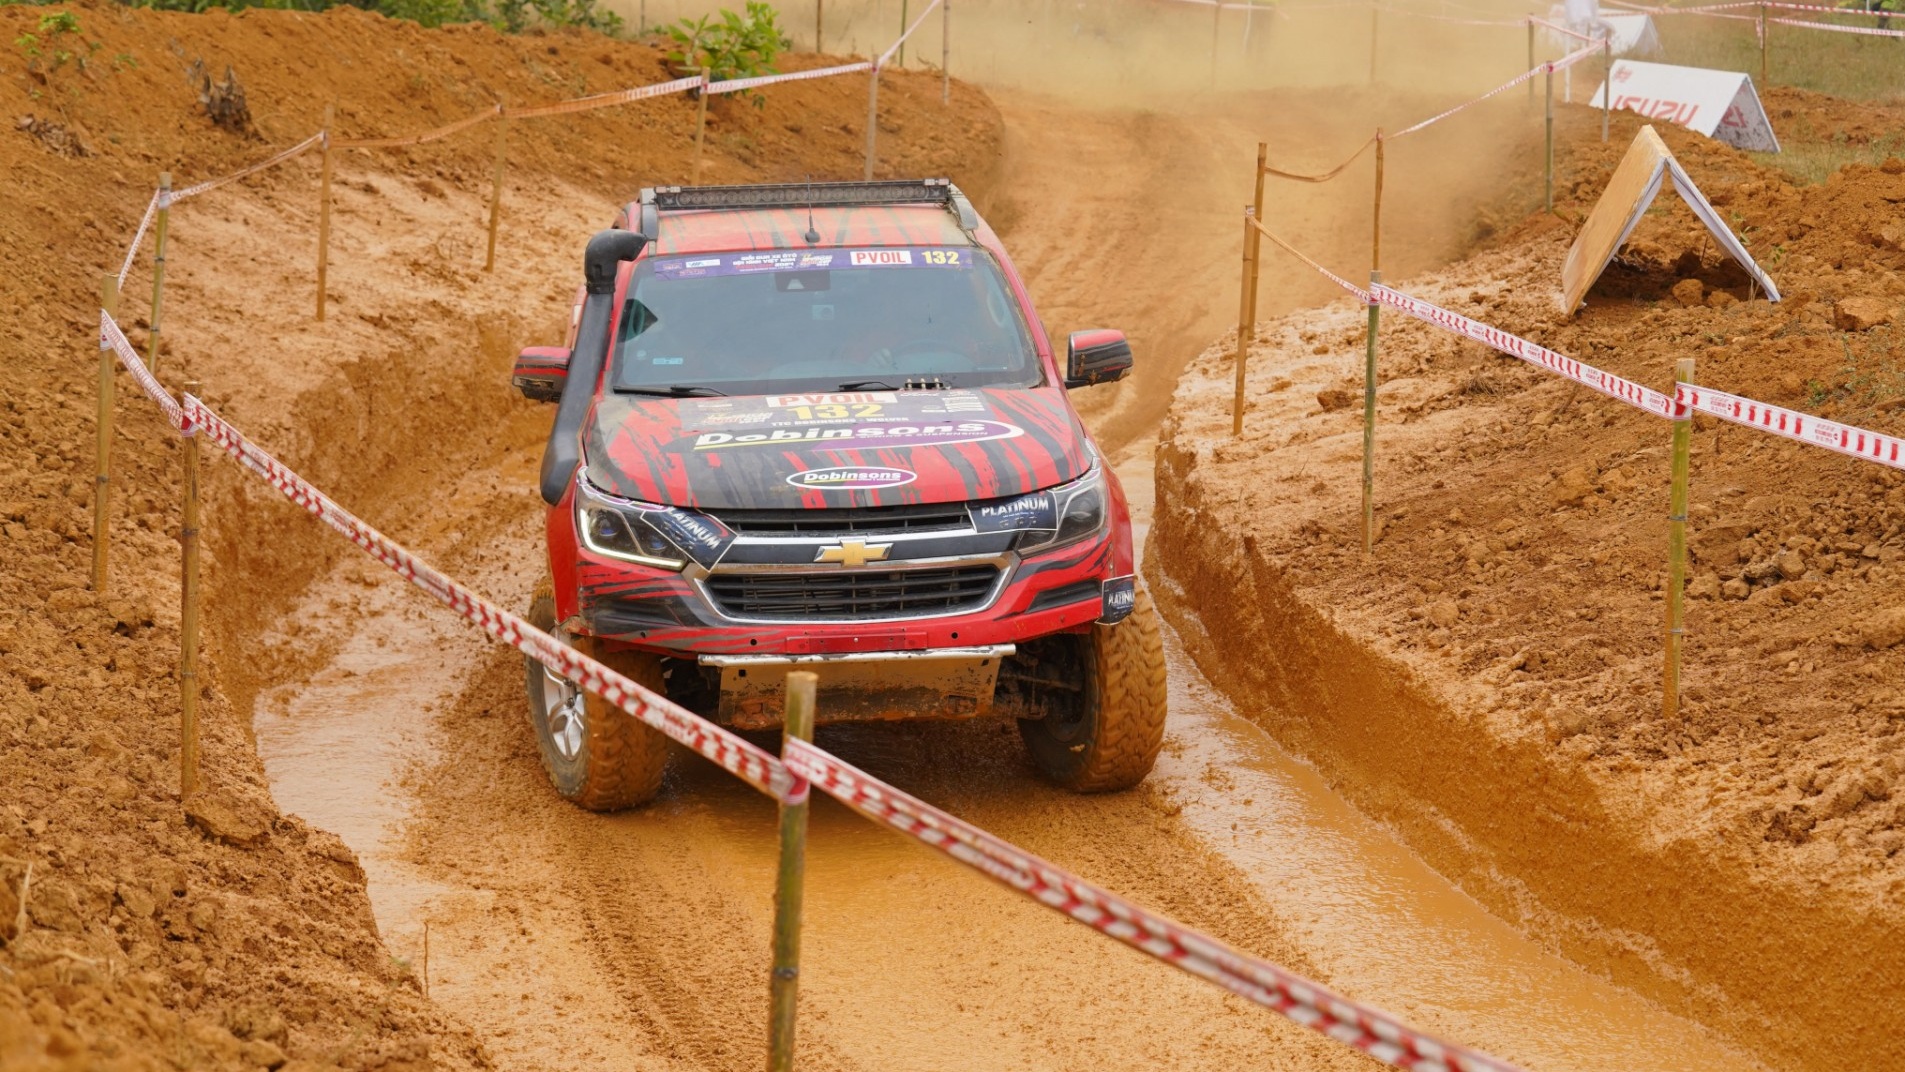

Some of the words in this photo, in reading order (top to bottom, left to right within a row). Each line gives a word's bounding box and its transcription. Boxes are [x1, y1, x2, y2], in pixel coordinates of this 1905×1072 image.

[1611, 94, 1699, 124] ISUZU
[856, 251, 908, 265] PVOIL
[921, 250, 960, 265] 132
[778, 392, 879, 407] PVOIL
[787, 403, 885, 420] 132
[694, 422, 986, 446] Dobinsons
[804, 471, 902, 482] Dobinsons
[981, 496, 1049, 517] PLATINUM
[667, 506, 722, 551] LATINUM
